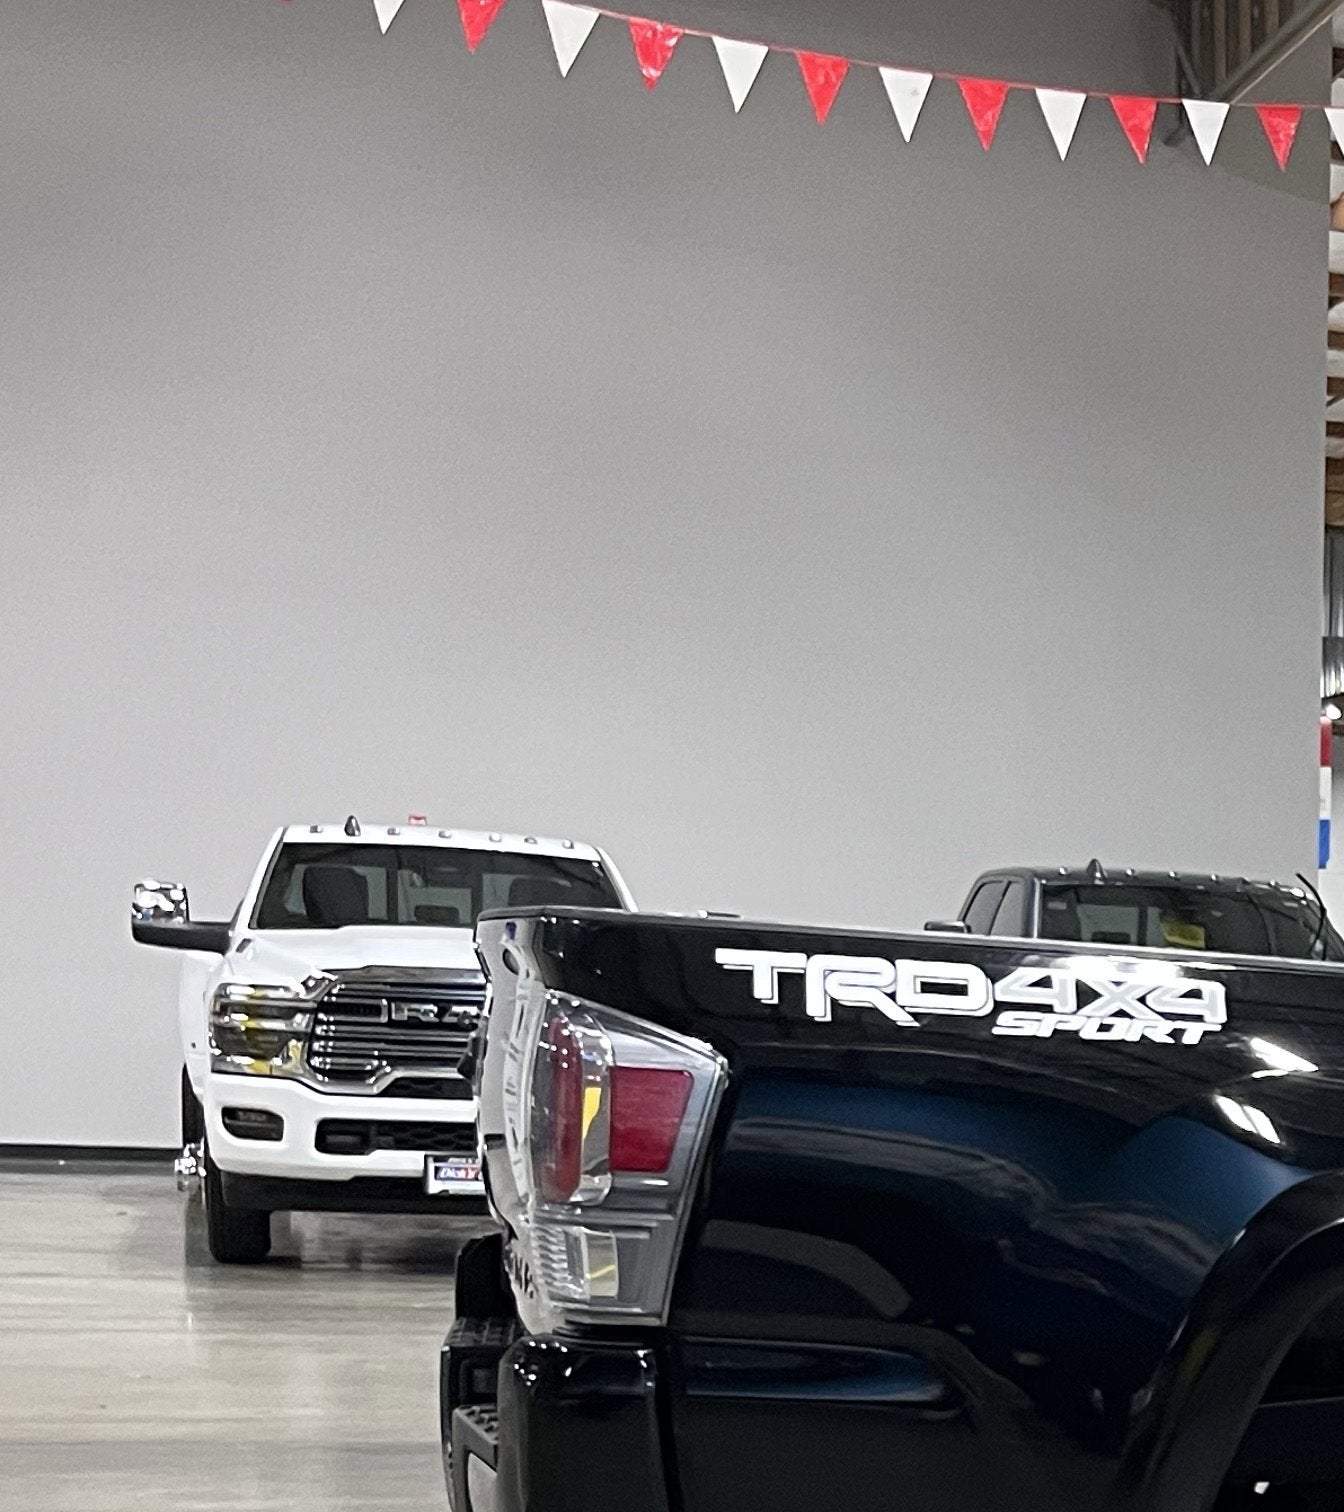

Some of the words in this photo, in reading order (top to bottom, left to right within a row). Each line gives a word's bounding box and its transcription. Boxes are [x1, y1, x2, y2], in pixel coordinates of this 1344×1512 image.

[715, 948, 994, 1027] TRD
[391, 1002, 482, 1023] RA
[992, 1011, 1222, 1045] SPORT
